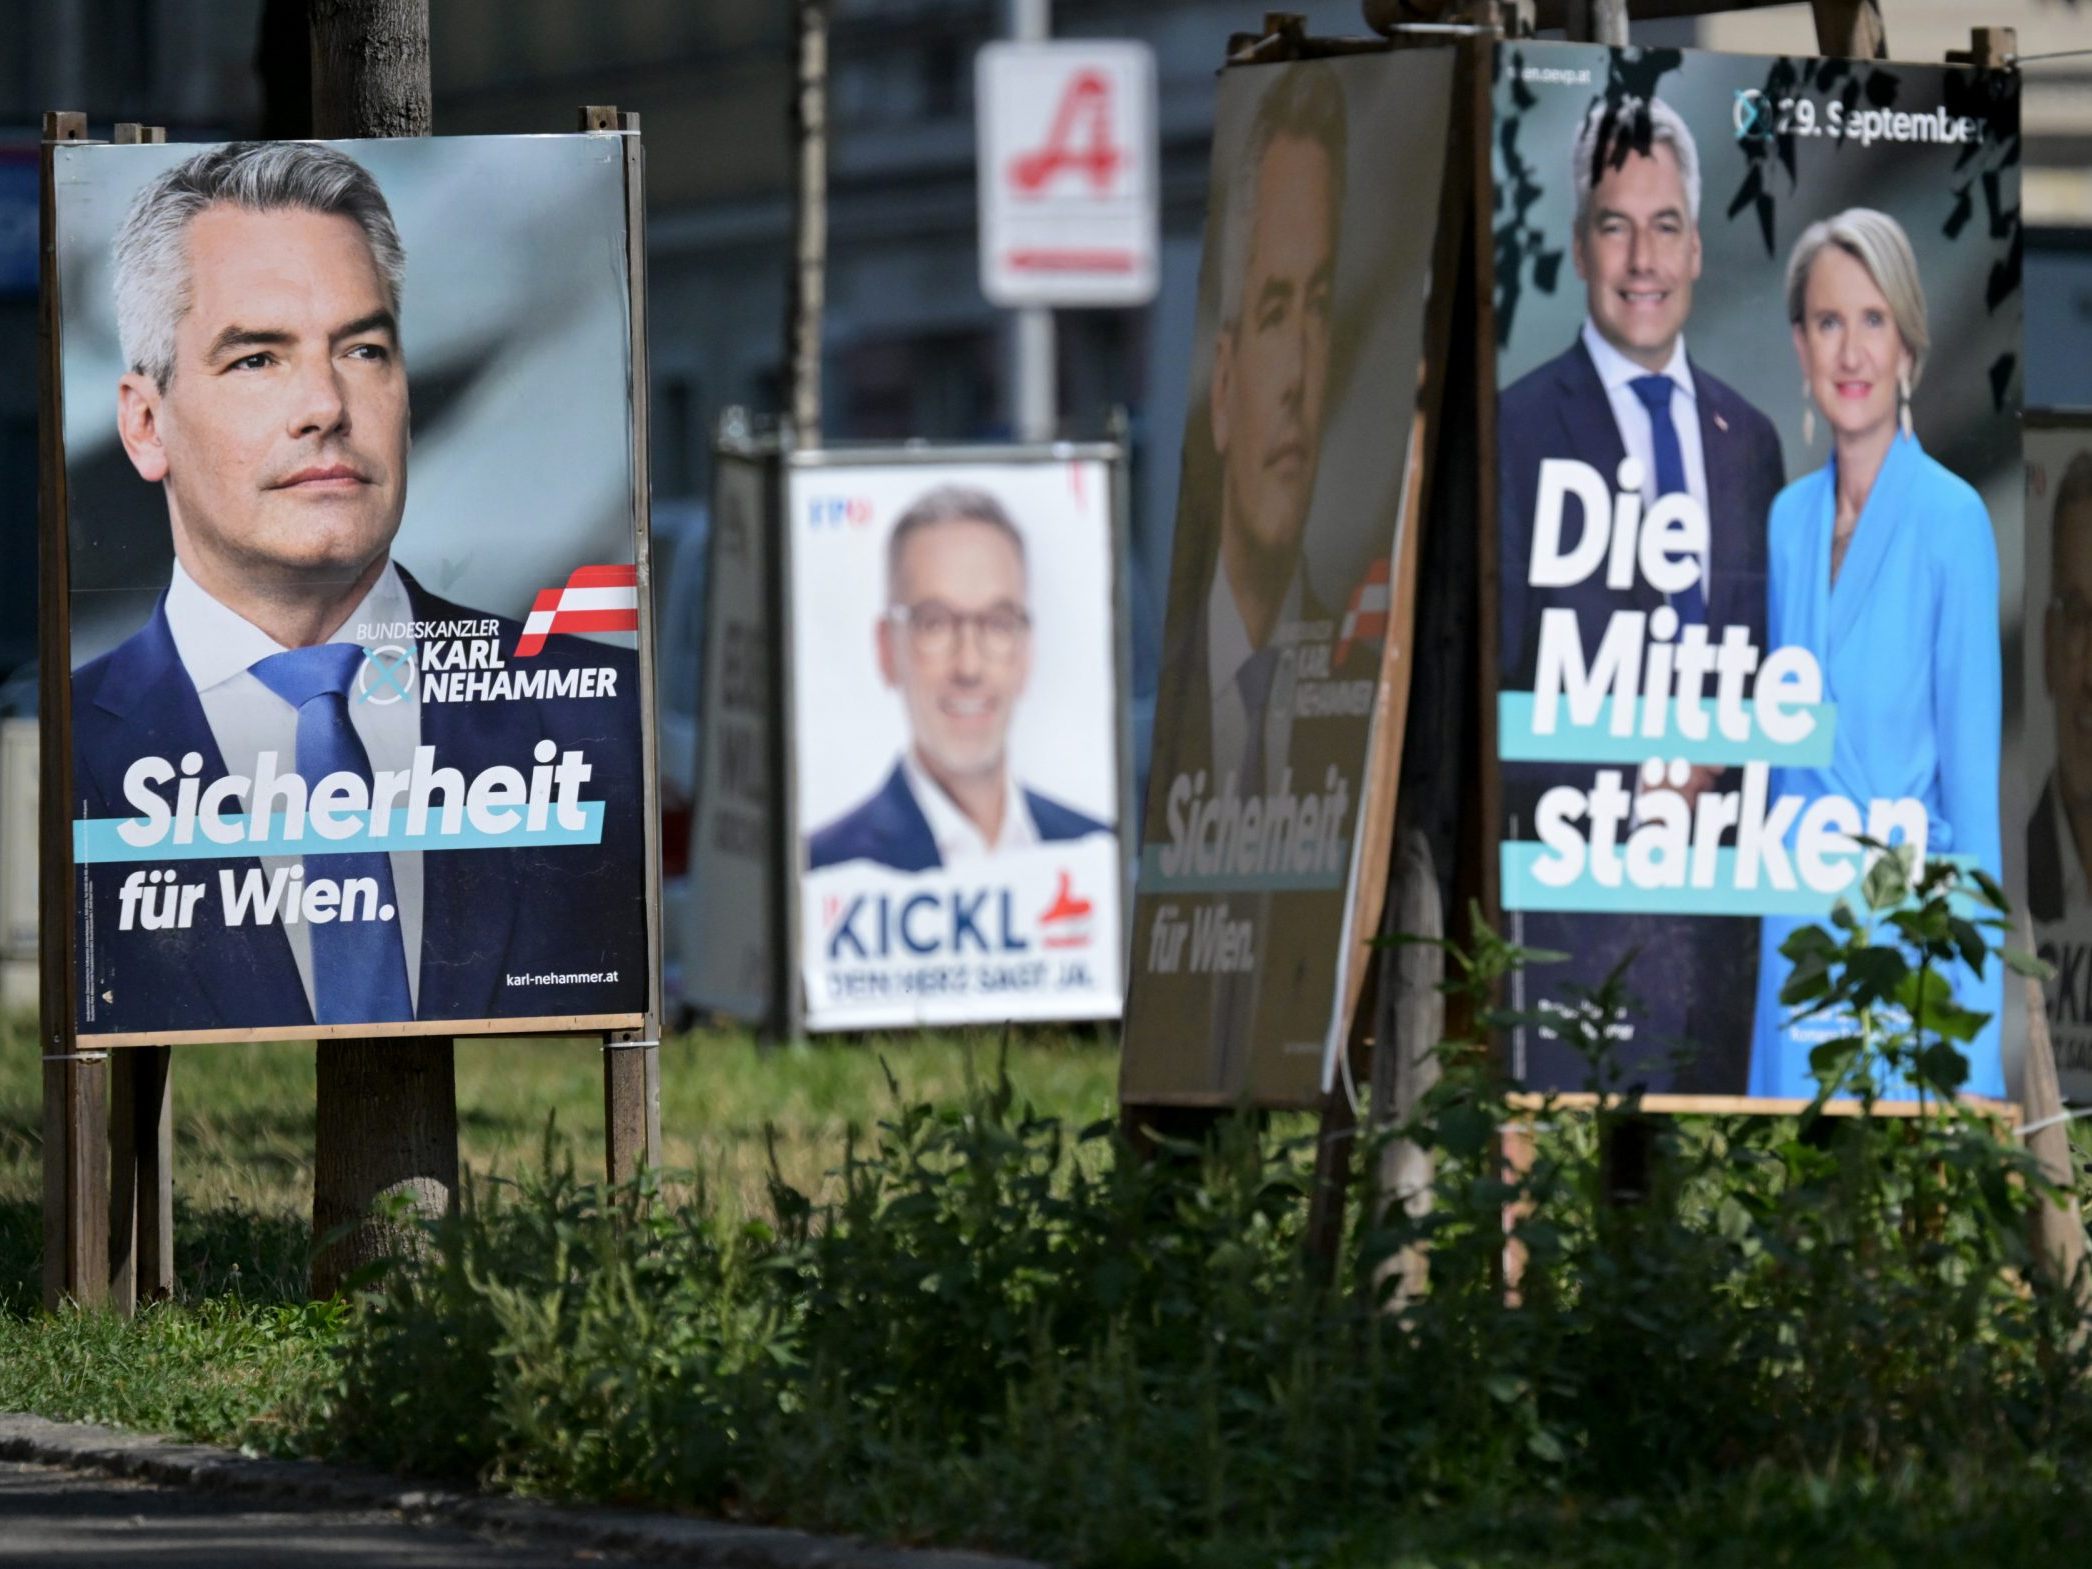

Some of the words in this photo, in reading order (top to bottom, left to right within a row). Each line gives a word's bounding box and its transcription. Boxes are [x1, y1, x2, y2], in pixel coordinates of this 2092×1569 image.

[1826, 101, 1988, 147] September
[1528, 457, 1710, 594] Die
[356, 619, 499, 640] BUNDESKANZLER
[421, 639, 505, 671] KARL
[422, 667, 618, 703] NEHAMMER
[1531, 605, 1823, 744] Mitte
[117, 739, 593, 848] Sicherheit
[1160, 765, 1350, 878] Sicherheit
[1529, 756, 1930, 893] stärken
[118, 869, 204, 931] für
[218, 864, 395, 927] Wien.
[828, 889, 1028, 958] KICKL
[1148, 905, 1186, 973] für
[506, 970, 619, 986] karl-nehammer.at
